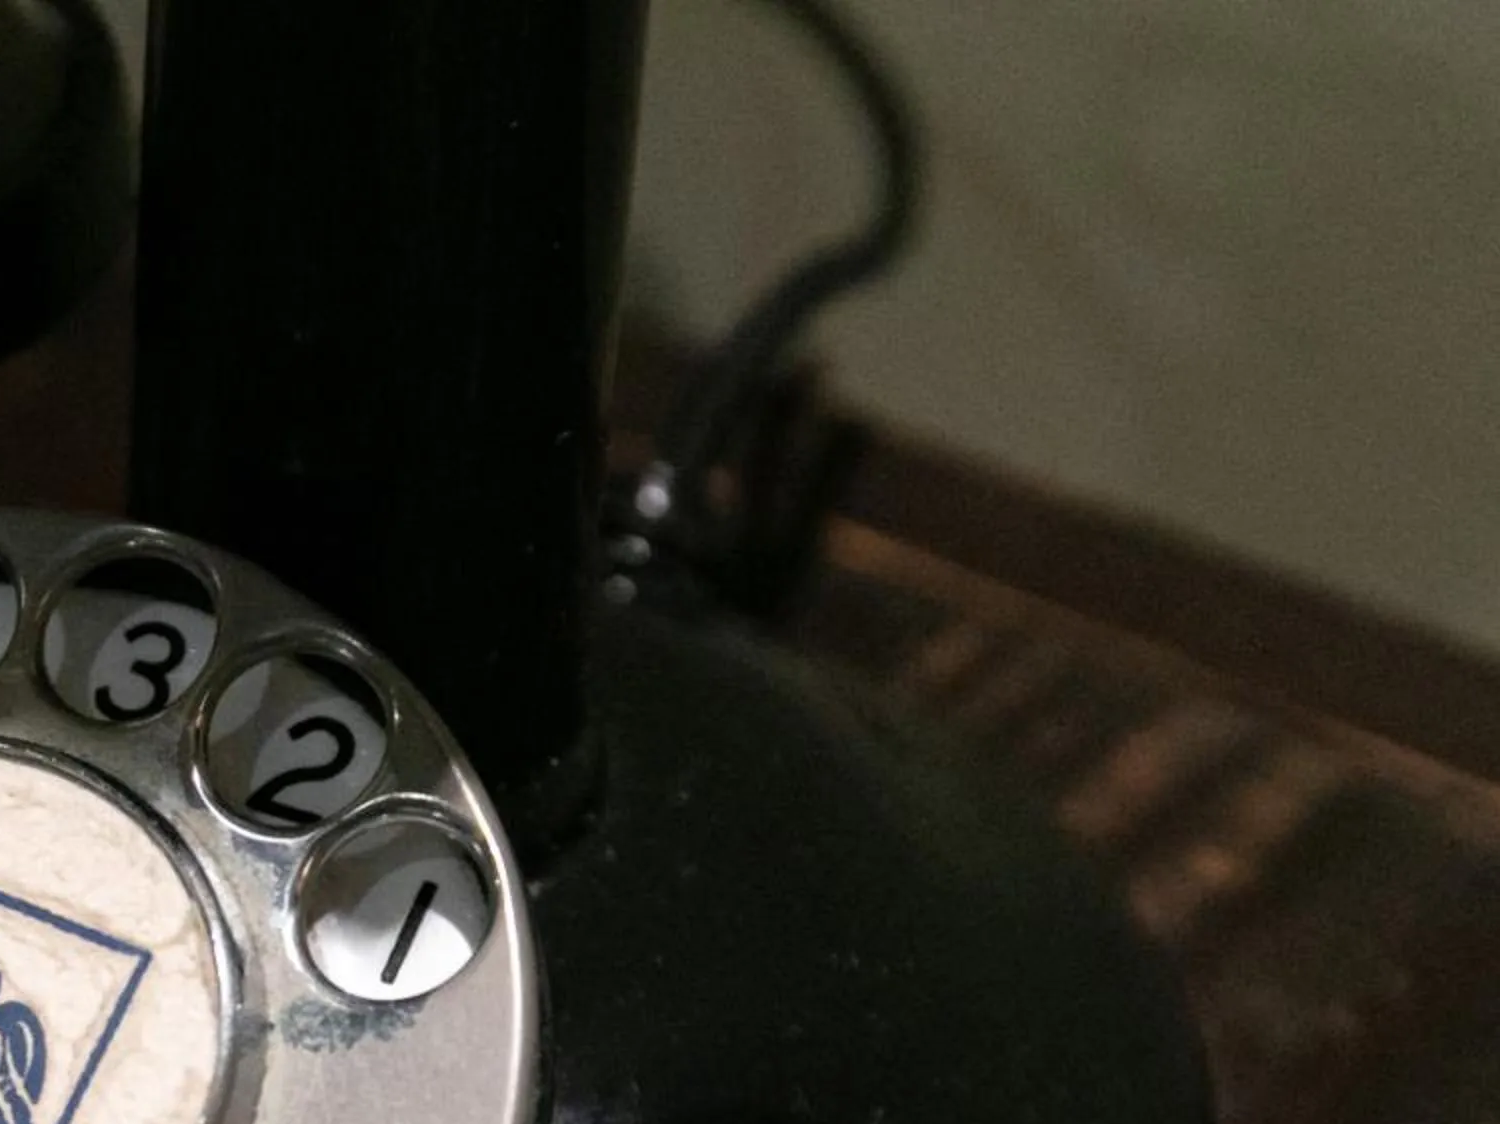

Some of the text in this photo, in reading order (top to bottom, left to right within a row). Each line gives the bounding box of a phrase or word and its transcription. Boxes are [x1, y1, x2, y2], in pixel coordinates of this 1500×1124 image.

[94, 621, 186, 721] 3
[246, 716, 355, 822] 2
[380, 880, 438, 985] 1
